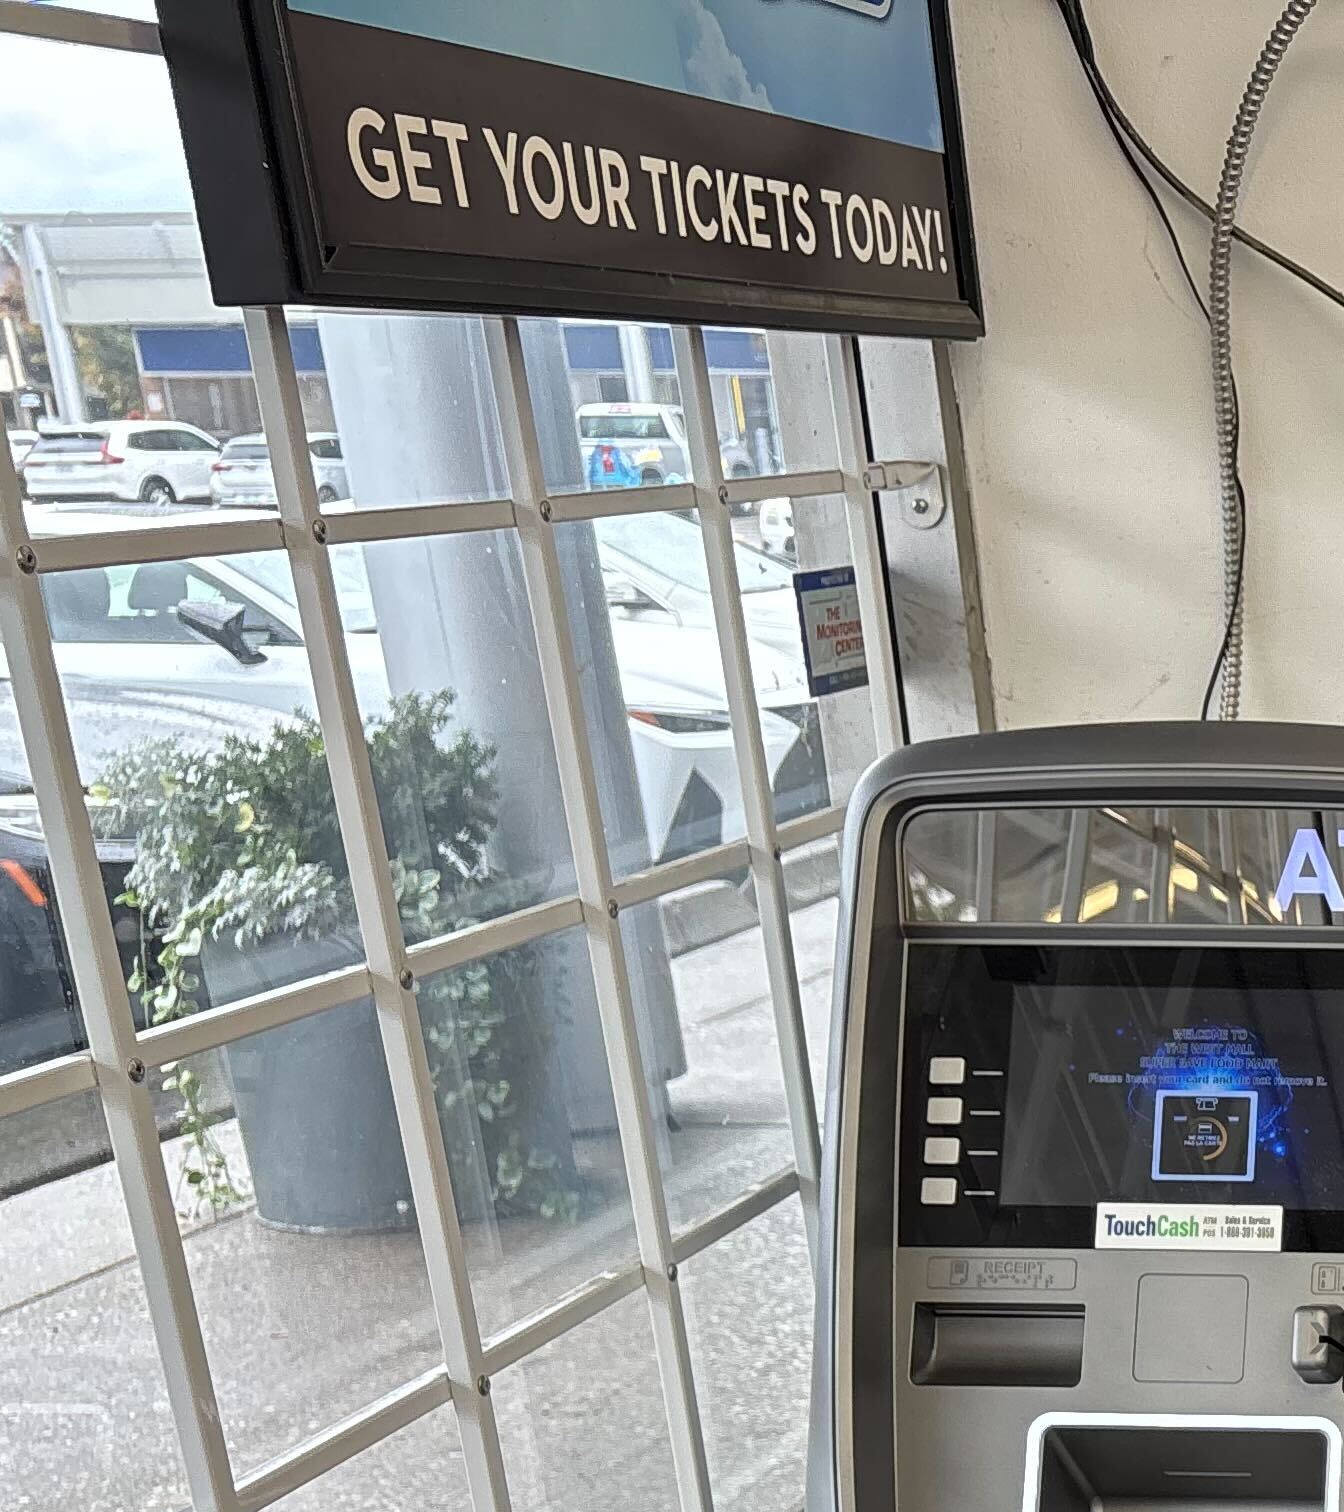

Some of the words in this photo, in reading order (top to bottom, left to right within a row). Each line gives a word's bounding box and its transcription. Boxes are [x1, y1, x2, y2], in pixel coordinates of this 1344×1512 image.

[347, 107, 470, 209] GET
[481, 127, 636, 231] YOUR
[640, 155, 817, 256] TICKETS
[820, 190, 949, 275] TODAY!
[826, 608, 840, 621] THE
[1105, 1214, 1199, 1237] TouchCash
[983, 1261, 1046, 1275] RECEIPT
